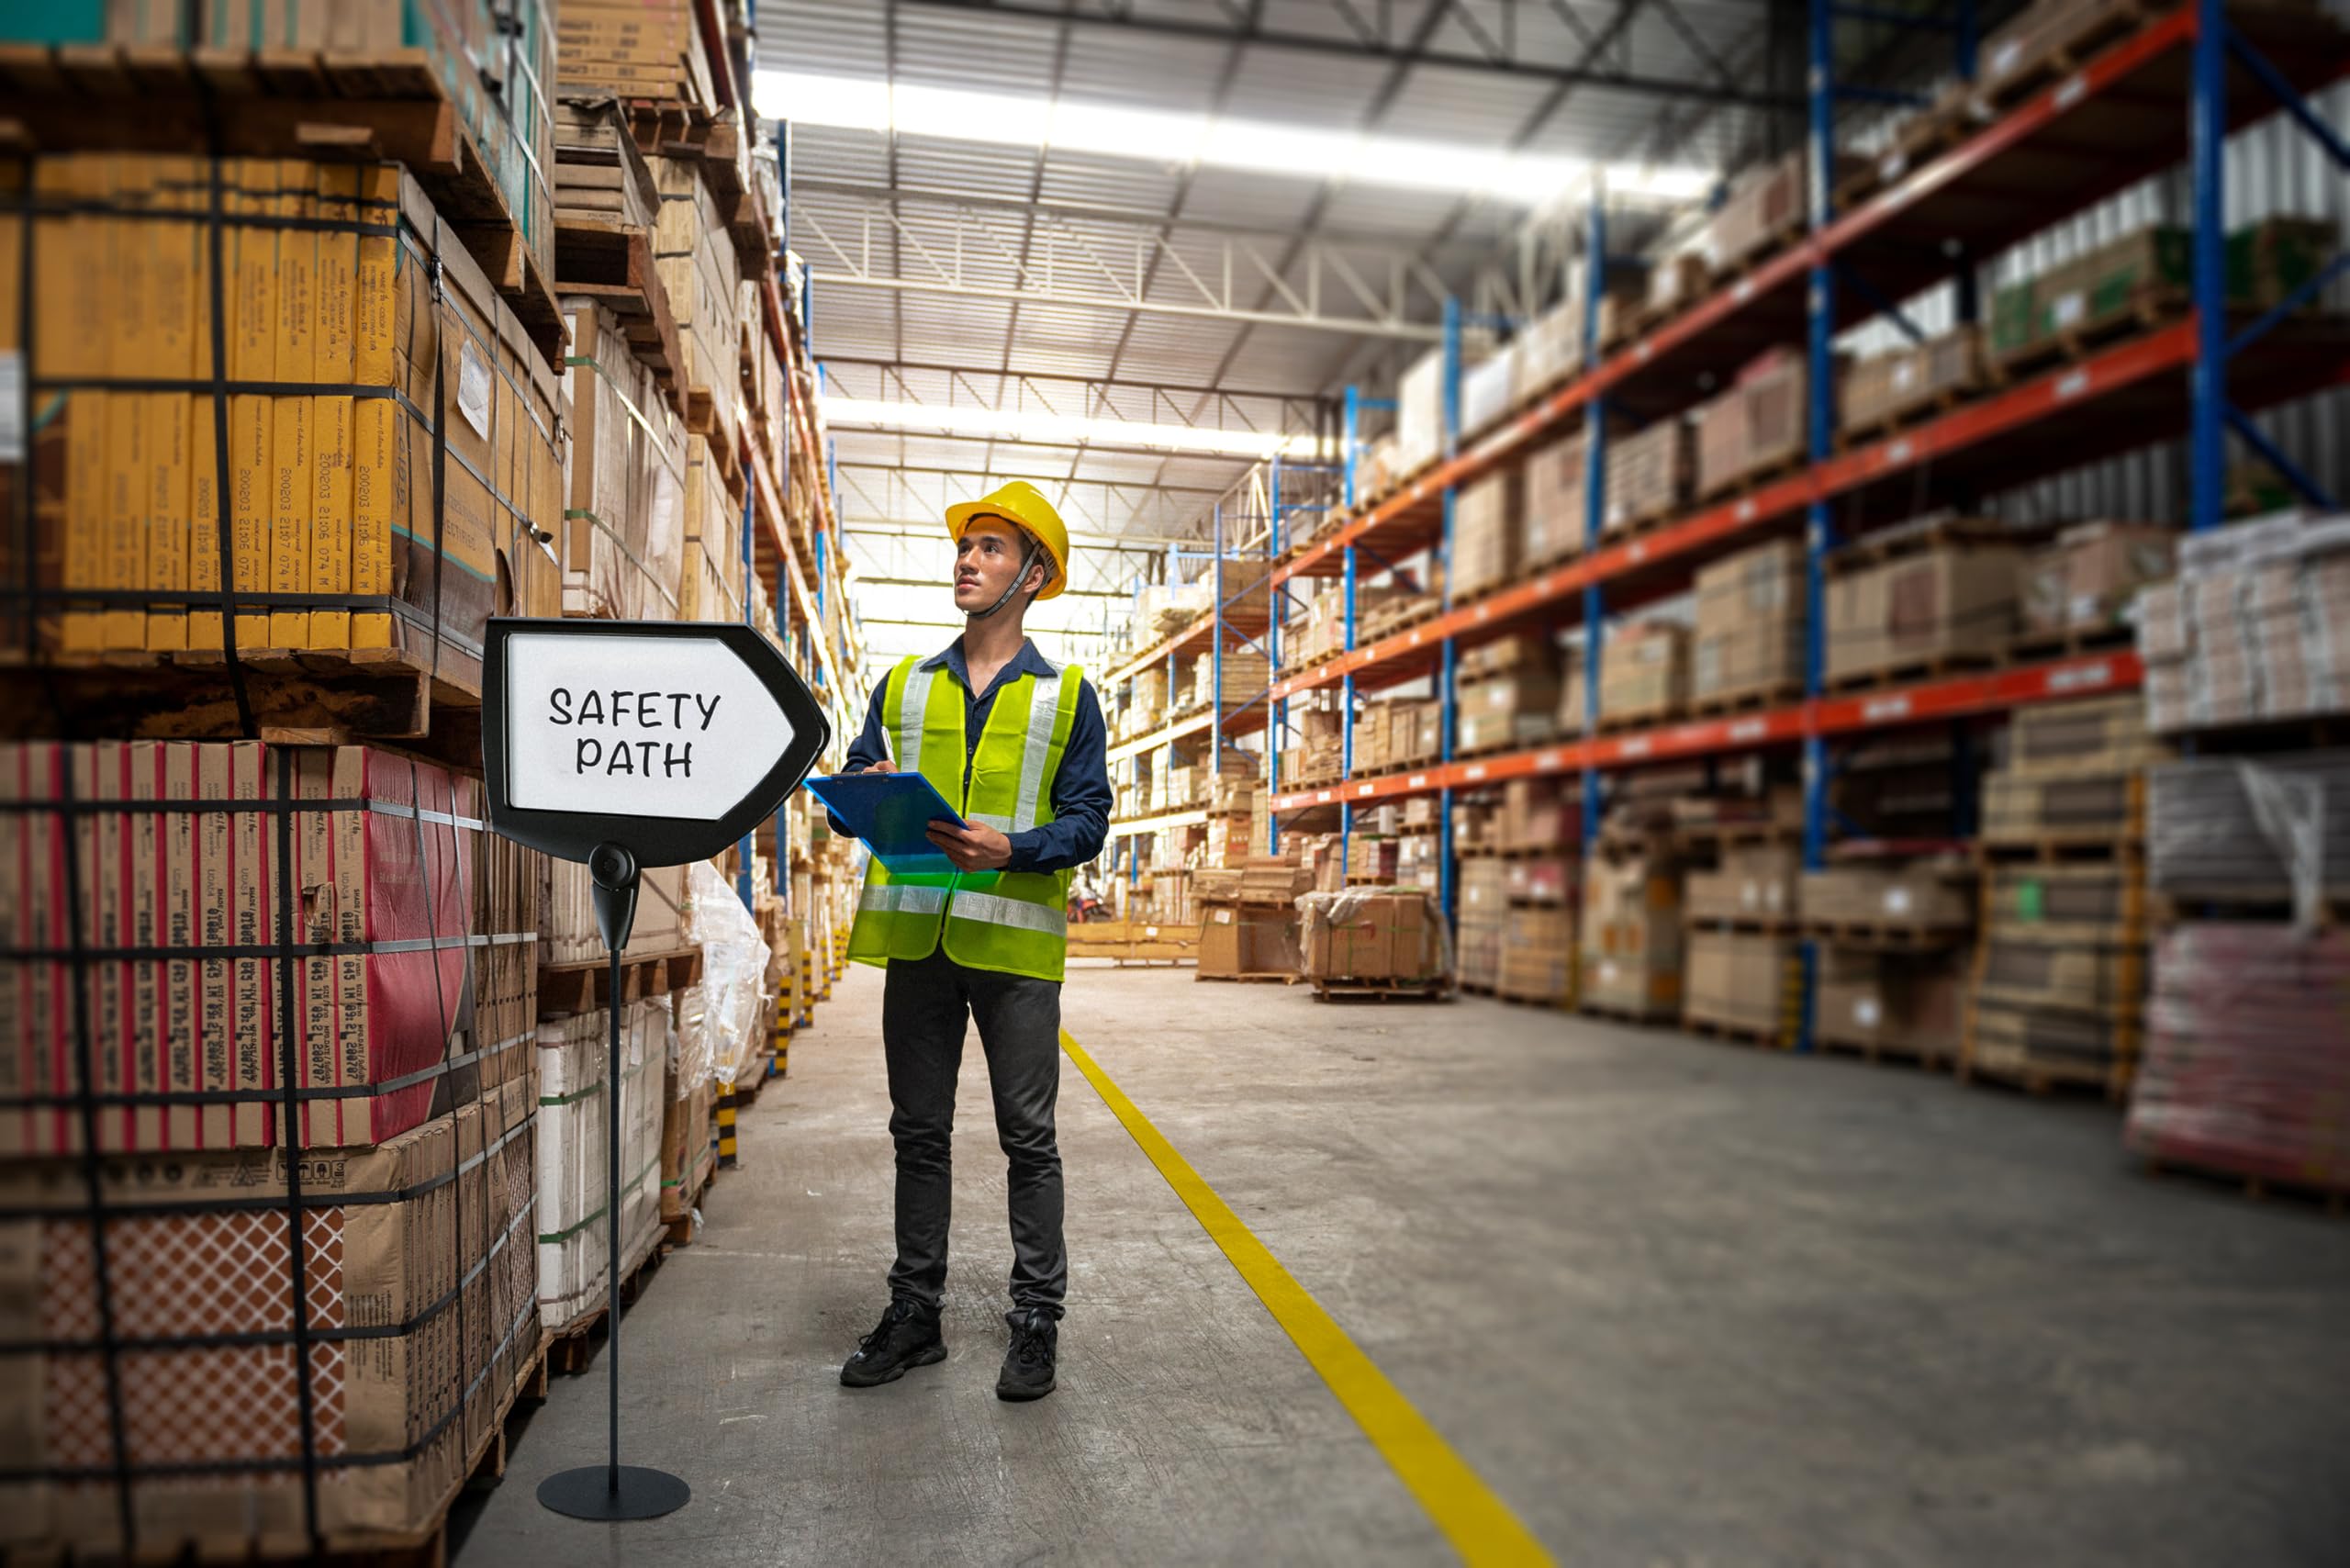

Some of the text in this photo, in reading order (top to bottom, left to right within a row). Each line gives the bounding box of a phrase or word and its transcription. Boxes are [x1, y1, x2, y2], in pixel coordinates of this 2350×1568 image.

[240, 469, 251, 511] 200203
[358, 465, 370, 508] 200203
[239, 518, 251, 550] 21:06
[279, 467, 292, 590] 200203 21:07 074 M
[318, 454, 330, 586] 200203 21:06 074 M
[358, 514, 370, 546] 21:06
[197, 560, 208, 580] 074
[239, 557, 249, 577] 074
[358, 553, 369, 574] 074
[550, 689, 721, 730] SAFETY
[577, 739, 691, 778] PATH
[312, 961, 323, 981] 045
[344, 961, 355, 980] 045
[312, 987, 323, 1000] 1M
[344, 987, 355, 999] 1M
[313, 1044, 324, 1081] 200707
[346, 1042, 358, 1080] 200707
